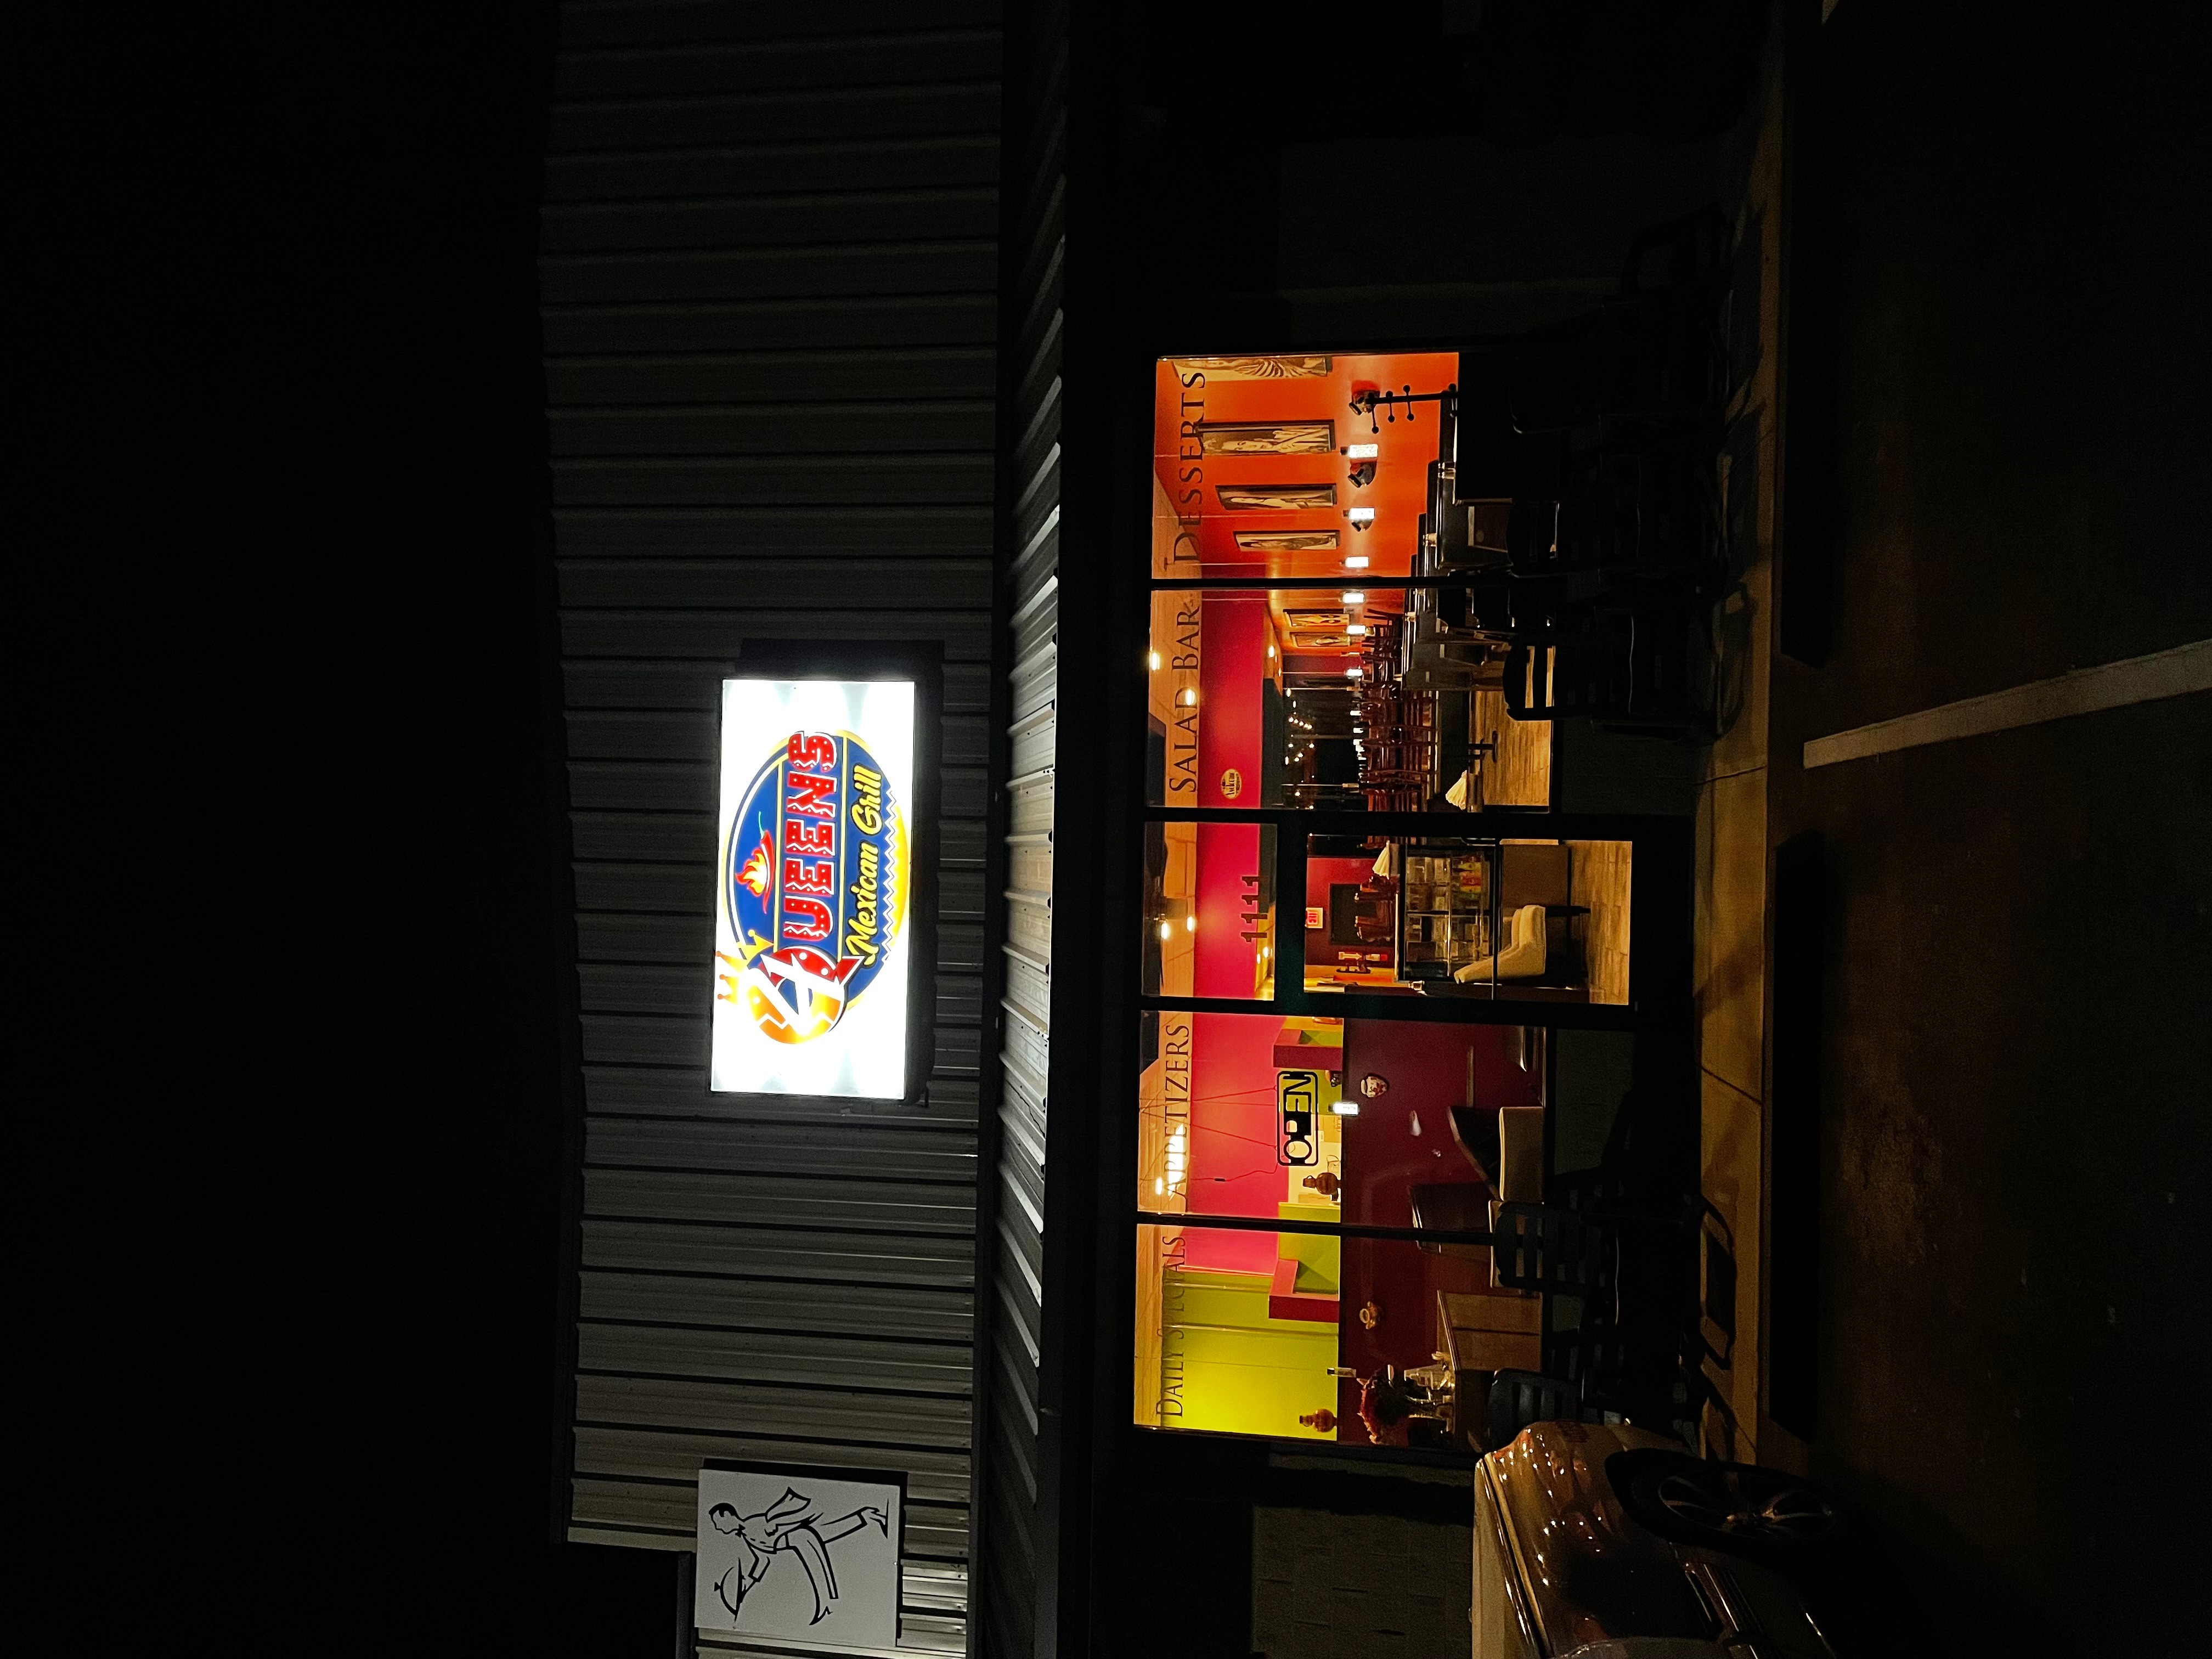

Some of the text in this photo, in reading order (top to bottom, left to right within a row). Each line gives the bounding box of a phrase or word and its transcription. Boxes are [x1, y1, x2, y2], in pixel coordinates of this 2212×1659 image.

[1173, 372, 1205, 562] DESSERTS
[1169, 606, 1200, 793] SALAD BAR
[845, 765, 882, 966] Mexican Grill
[1240, 876, 1268, 943] 1111
[1164, 1024, 1189, 1198] APPETIZERS
[1283, 1073, 1312, 1159] OPEN
[1155, 1236, 1186, 1418] DAILY SPECIALS
